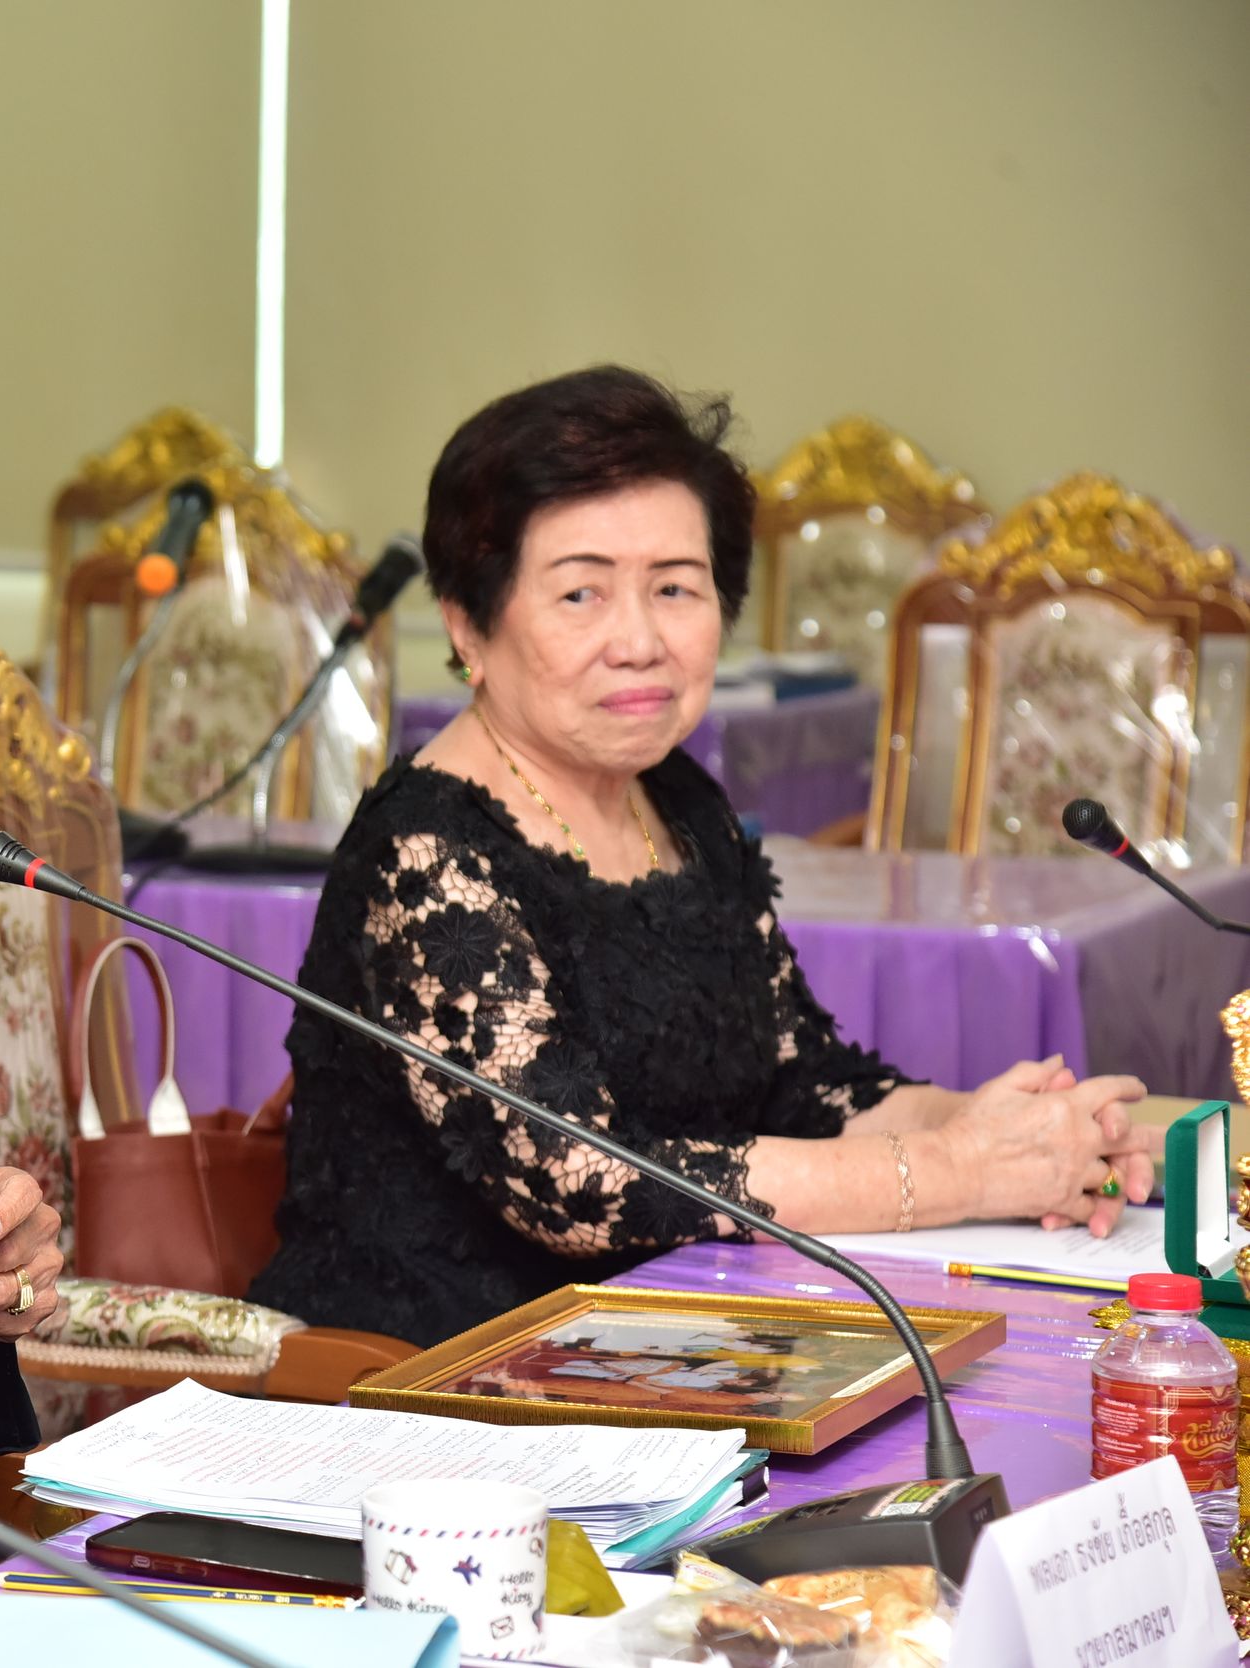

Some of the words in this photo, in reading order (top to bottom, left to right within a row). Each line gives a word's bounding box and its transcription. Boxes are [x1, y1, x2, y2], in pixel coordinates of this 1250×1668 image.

[1076, 1518, 1117, 1572] ธงชัย
[499, 1572, 535, 1585] Hello
[371, 1592, 402, 1611] Hello
